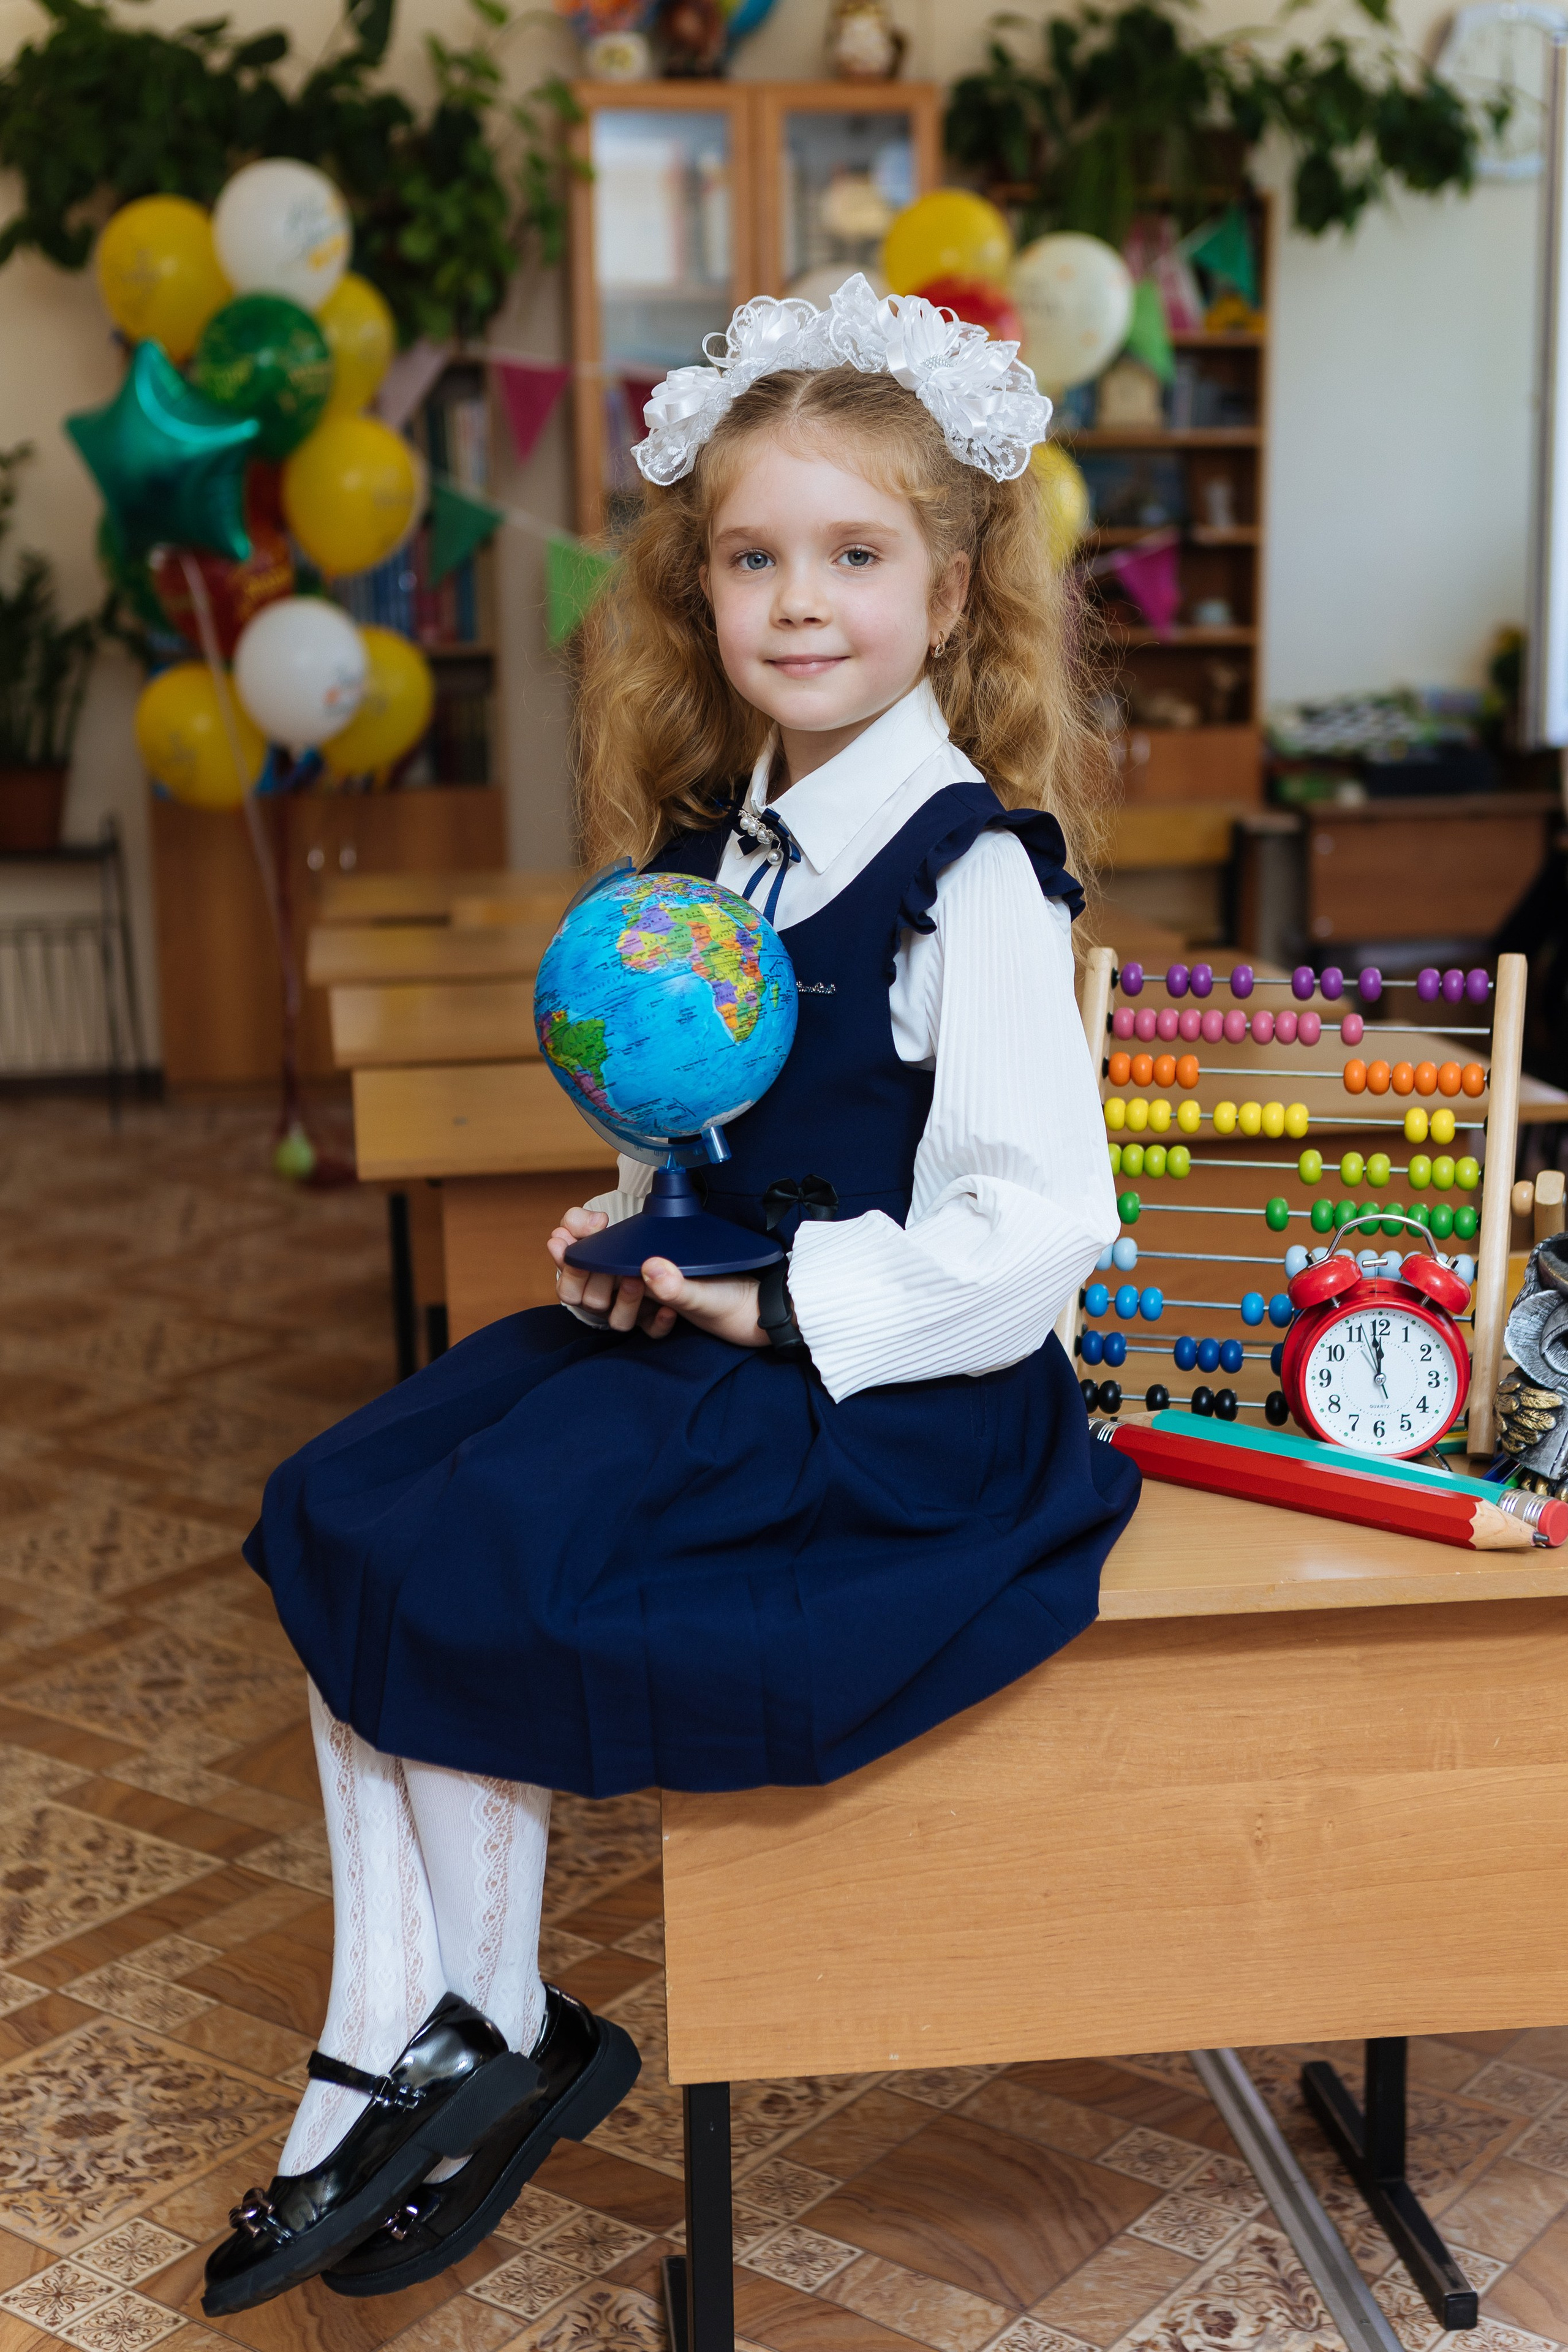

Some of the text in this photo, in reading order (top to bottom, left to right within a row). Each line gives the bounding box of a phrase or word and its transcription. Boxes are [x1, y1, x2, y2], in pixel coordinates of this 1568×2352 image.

[1346, 1325, 1363, 1343] 11
[1370, 1319, 1390, 1336] 12
[1401, 1325, 1410, 1343] 1
[1326, 1344, 1345, 1362] 10
[1420, 1344, 1432, 1361] 2
[1319, 1368, 1332, 1388] 9
[1428, 1370, 1441, 1388] 3
[1328, 1394, 1341, 1413] 8
[1415, 1395, 1429, 1413] 4
[1348, 1414, 1360, 1431] 7
[1373, 1420, 1385, 1438] 6
[1400, 1414, 1412, 1431] 5
